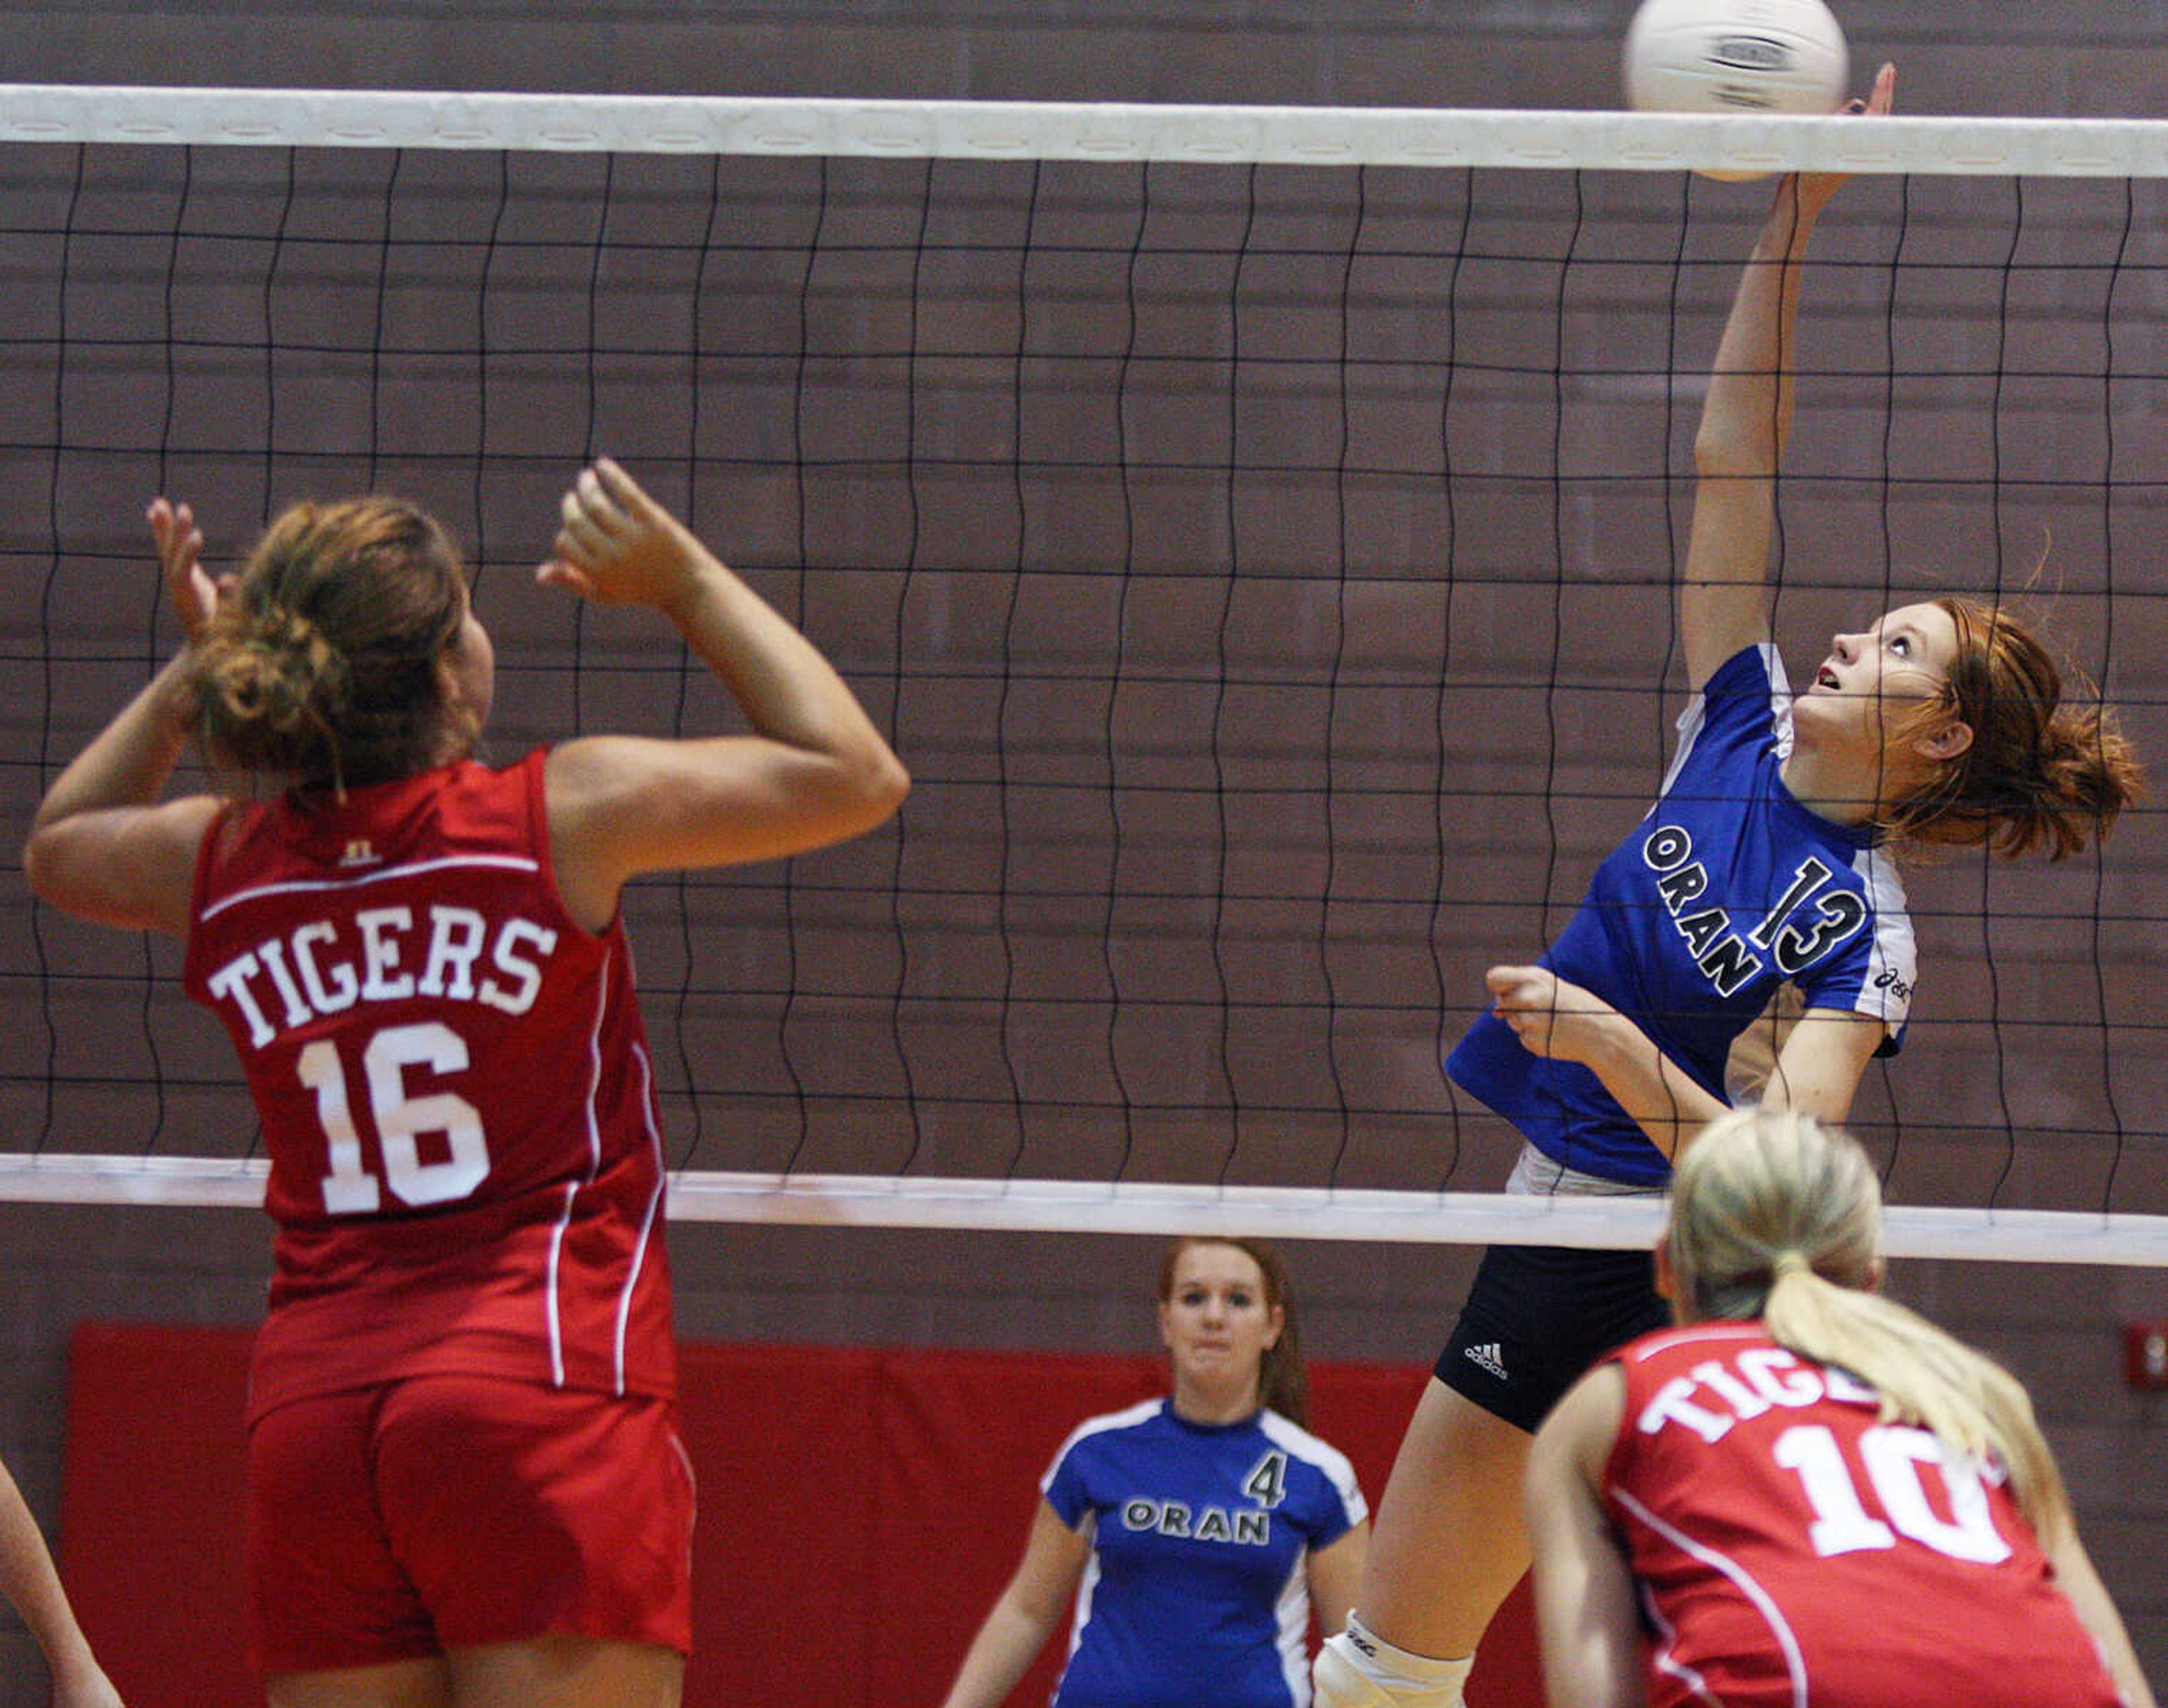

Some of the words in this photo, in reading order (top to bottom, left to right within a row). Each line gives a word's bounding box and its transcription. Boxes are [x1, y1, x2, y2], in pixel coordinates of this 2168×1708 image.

[207, 905, 557, 1049] TIGERS
[1644, 825, 1763, 997] ORAN
[1747, 856, 1865, 974] 13
[296, 1022, 490, 1215] 16
[1122, 1496, 1271, 1546] ORAN
[1245, 1449, 1288, 1509] 4
[1773, 1425, 2013, 1564] 10
